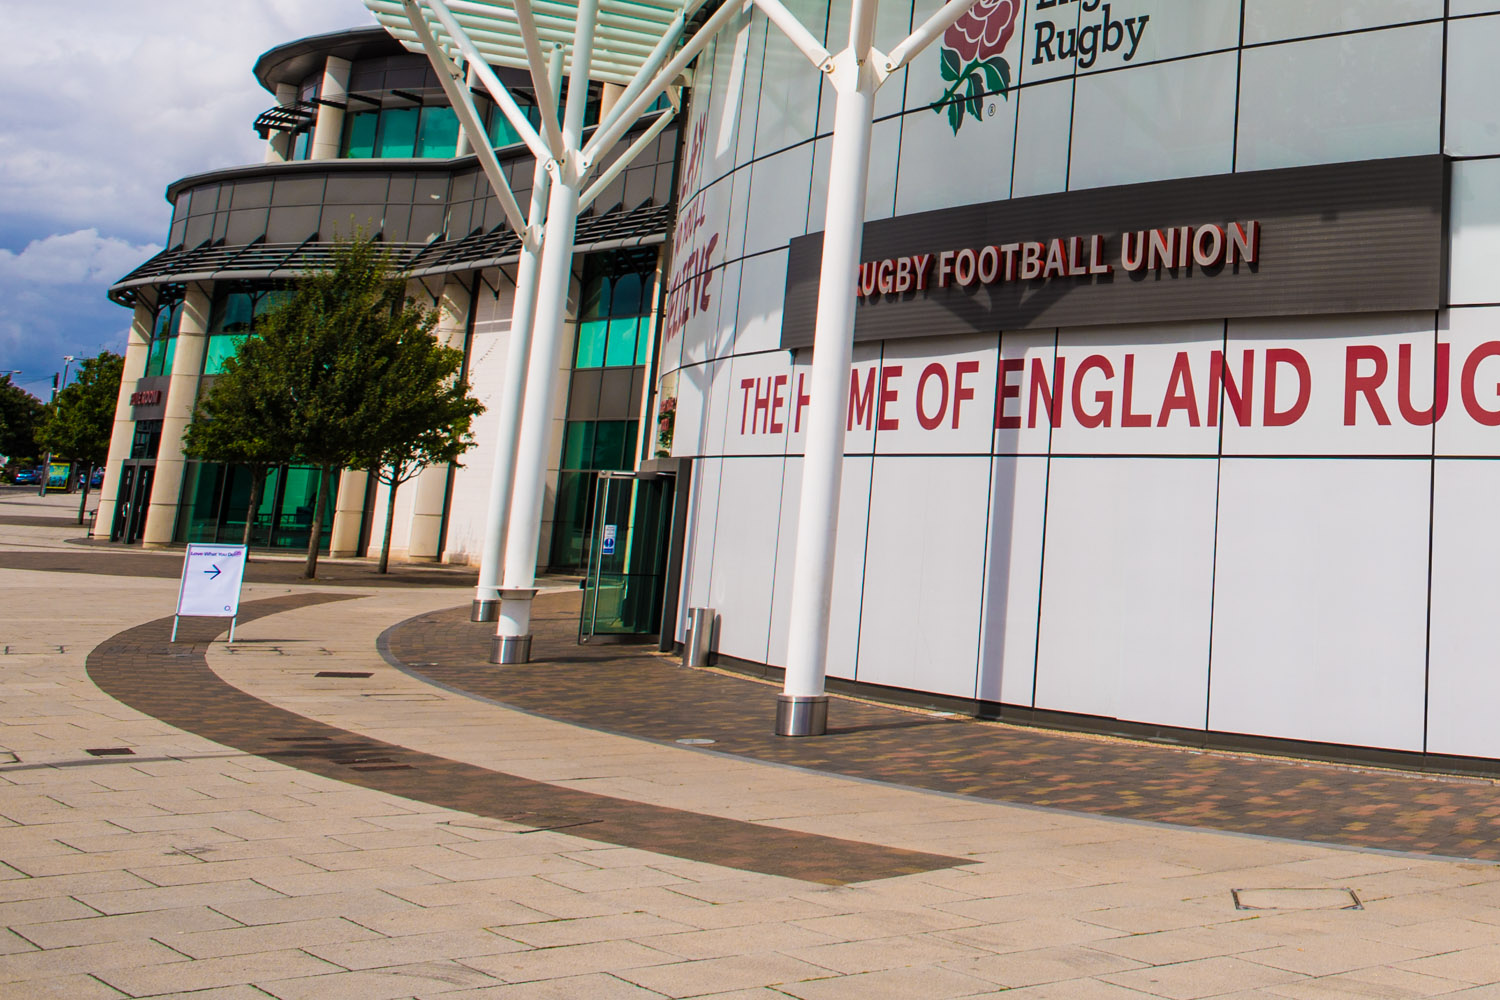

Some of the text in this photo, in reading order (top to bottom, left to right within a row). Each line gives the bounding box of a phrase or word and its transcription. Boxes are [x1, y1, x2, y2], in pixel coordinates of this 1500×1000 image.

[1032, 3, 1150, 69] Rugby
[938, 234, 1113, 288] FOOTBALL
[1121, 220, 1259, 272] UNION
[741, 374, 788, 435] THE
[794, 365, 903, 433] HME
[916, 360, 980, 431] OF
[995, 347, 1313, 431] ENGLAND
